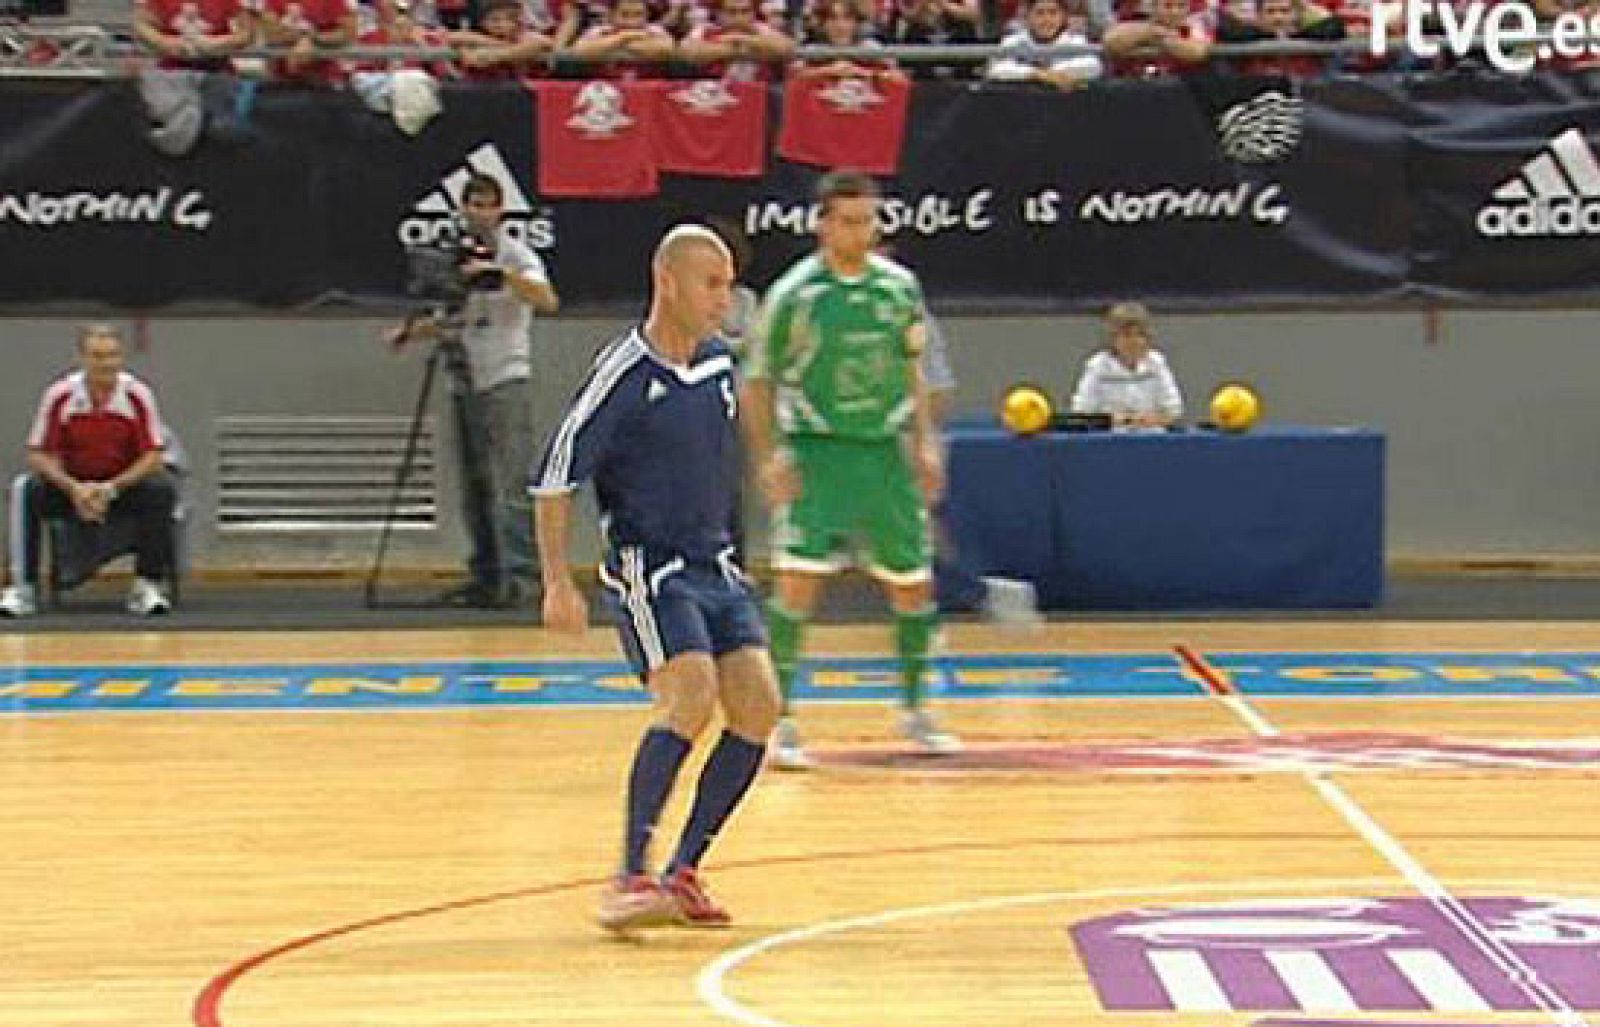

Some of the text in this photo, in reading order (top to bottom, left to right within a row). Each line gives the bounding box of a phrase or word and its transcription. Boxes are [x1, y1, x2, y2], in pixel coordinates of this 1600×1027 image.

[745, 182, 1291, 235] IMSIBLE IS NOTHING
[398, 209, 555, 248] adas
[1134, 666, 1600, 684] TOR
